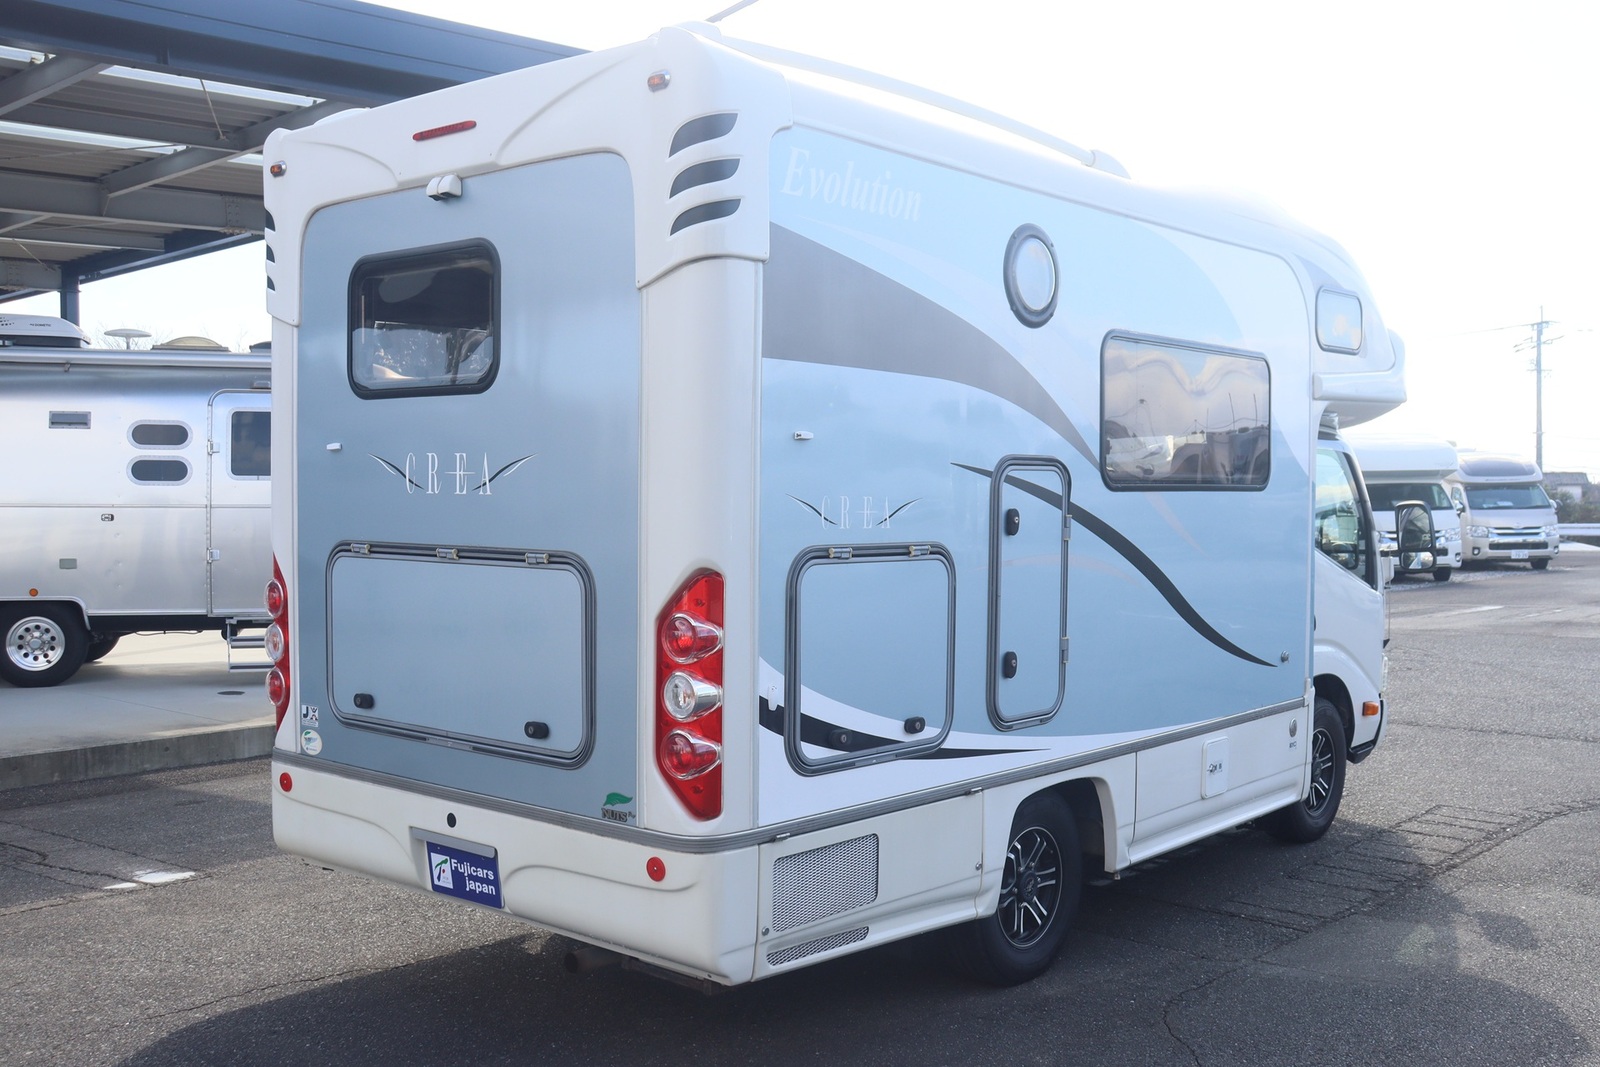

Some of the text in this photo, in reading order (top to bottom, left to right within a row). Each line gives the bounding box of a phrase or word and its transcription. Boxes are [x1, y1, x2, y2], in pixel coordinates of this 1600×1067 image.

[781, 146, 922, 222] Evolution
[405, 452, 492, 495] CREA
[821, 495, 891, 530] CREA
[601, 808, 628, 822] NUTS
[451, 858, 495, 880] Fujicars
[465, 877, 496, 895] japan
